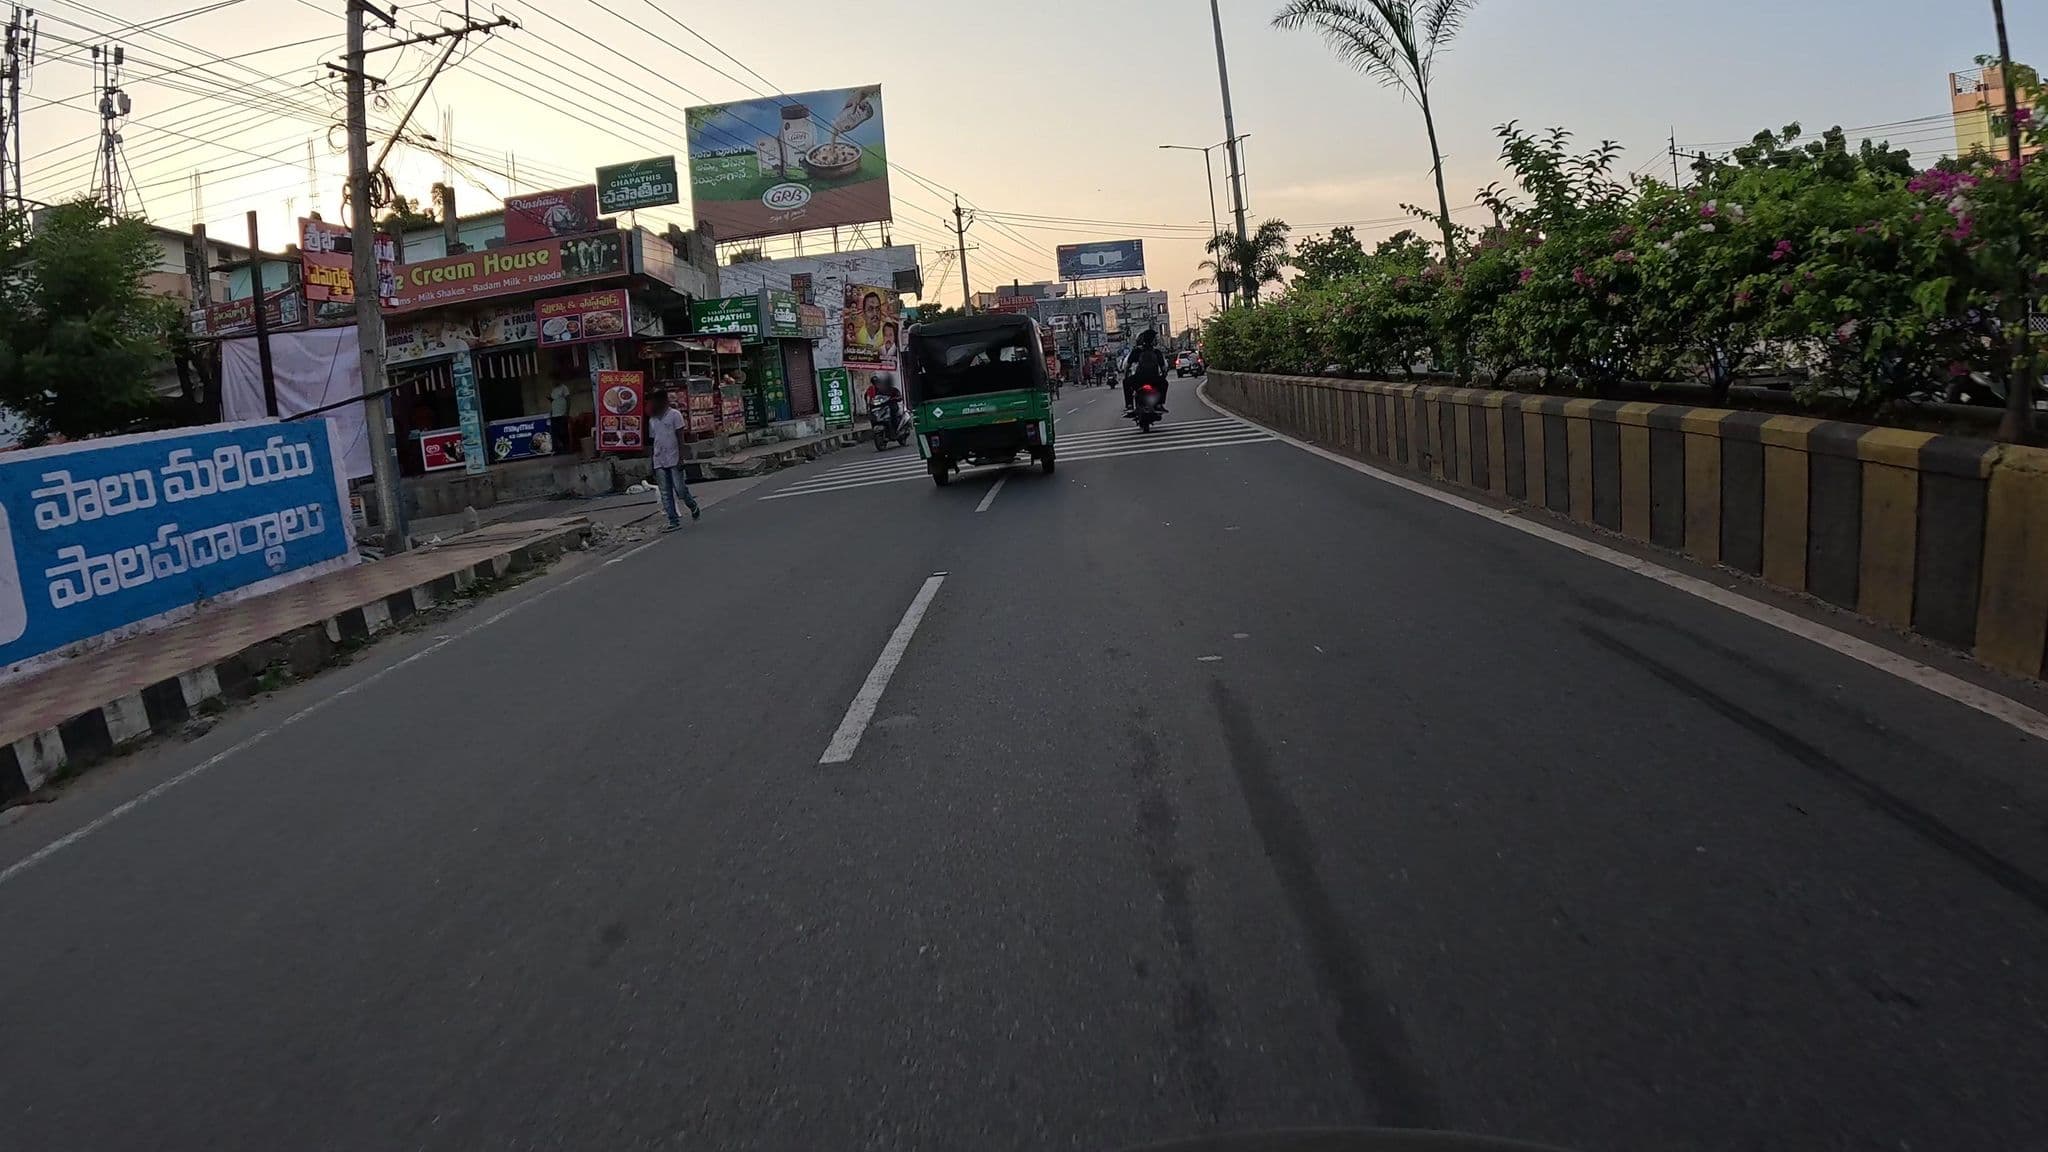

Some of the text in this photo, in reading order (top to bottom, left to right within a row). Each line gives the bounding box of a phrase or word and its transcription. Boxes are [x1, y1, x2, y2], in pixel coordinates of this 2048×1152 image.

[610, 173, 661, 188] CHAPATHIS
[771, 189, 801, 202] GRB
[411, 262, 476, 287] Cream
[483, 249, 549, 277] House
[418, 290, 436, 302] Milk
[436, 287, 465, 300] Shakes
[473, 282, 501, 293] Badam
[503, 277, 521, 288] Milk
[528, 272, 562, 284] Falooda
[567, 301, 576, 309] &
[701, 312, 752, 324] CHAPATHIS
[31, 436, 314, 530] పాలు మరియు
